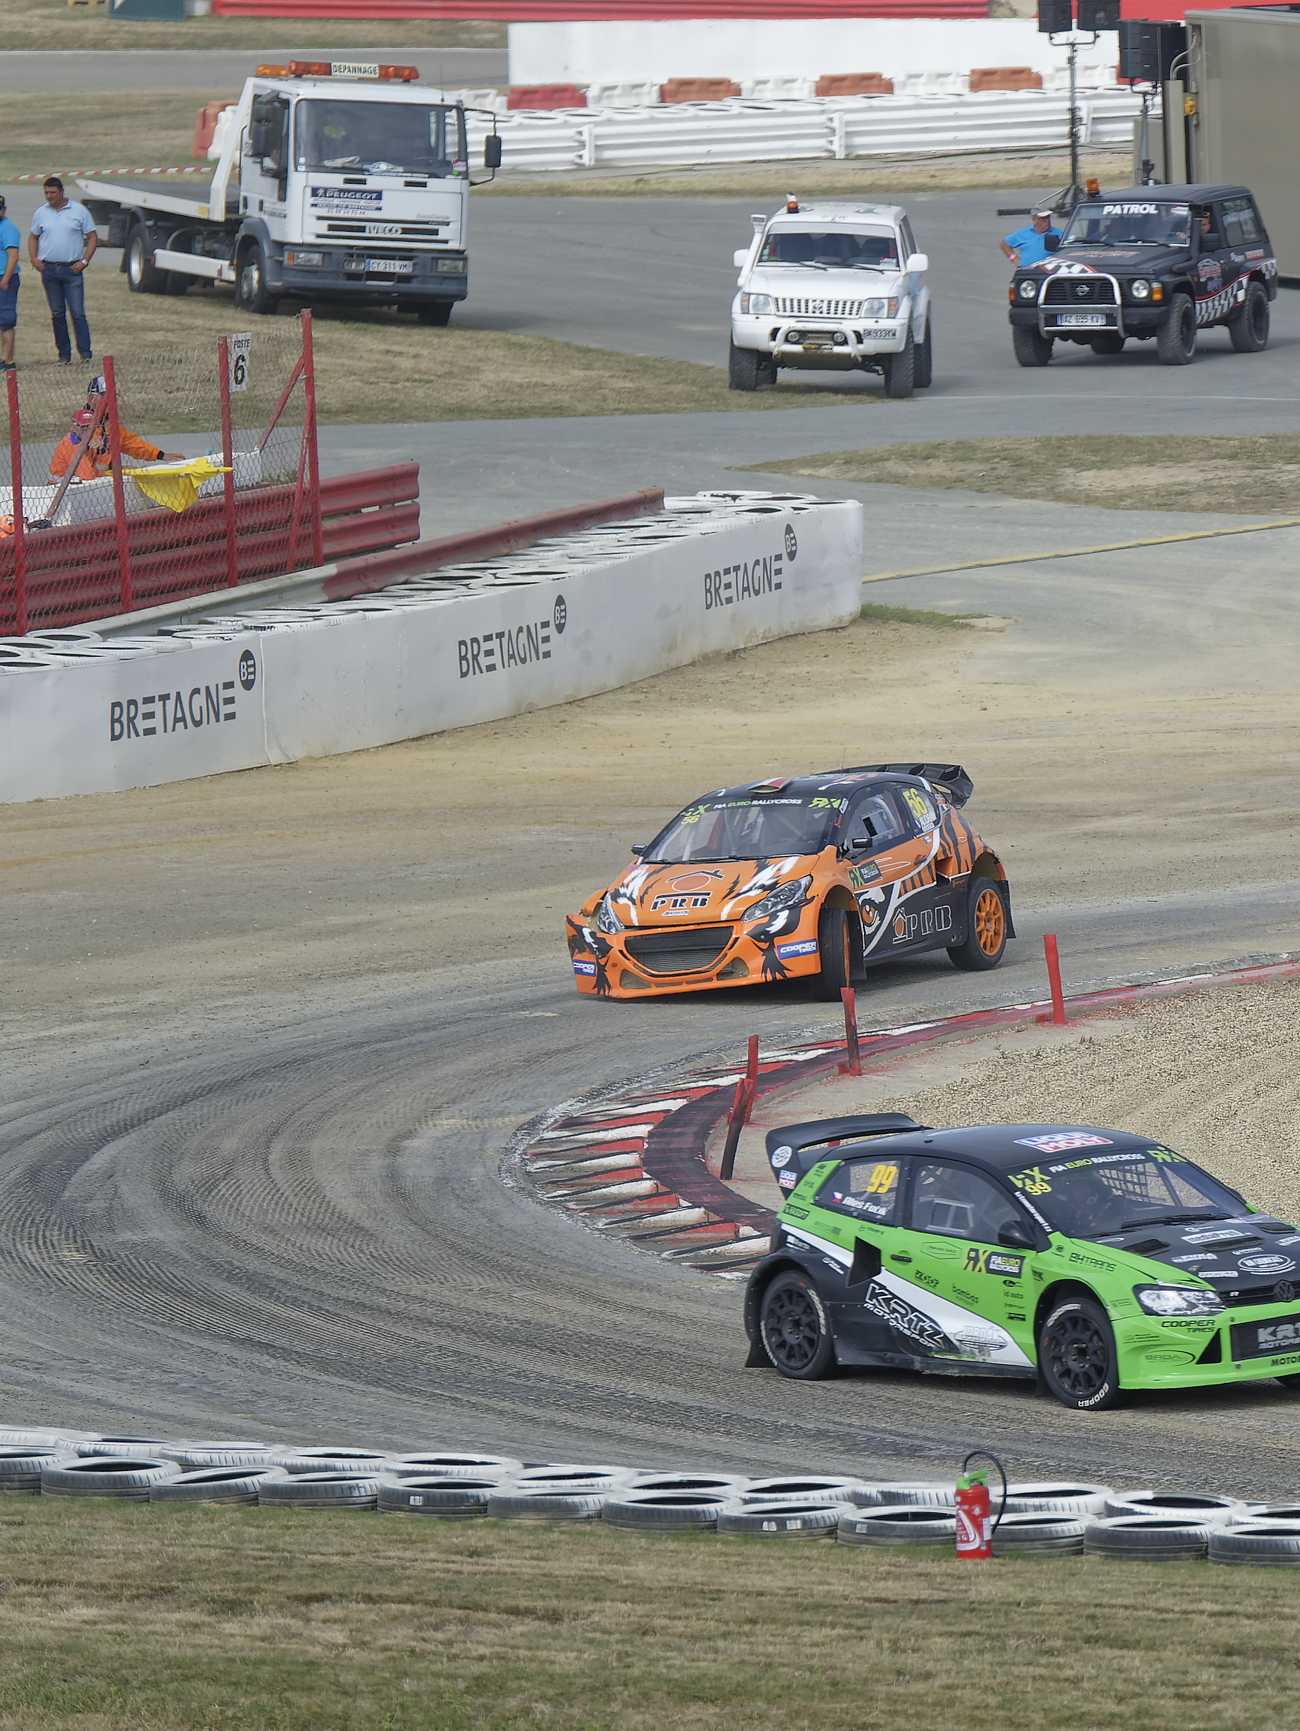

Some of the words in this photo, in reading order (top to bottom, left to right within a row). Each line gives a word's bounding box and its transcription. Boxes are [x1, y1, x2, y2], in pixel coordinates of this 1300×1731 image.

[325, 190, 378, 200] PEUGEOT
[1103, 204, 1159, 215] PATROL
[233, 354, 246, 385] 6
[704, 553, 783, 610] BRETAGNE
[458, 620, 552, 679] BRETAGNE
[110, 680, 237, 742] BRETAGNE
[751, 798, 803, 806] RALLYCROSS
[902, 787, 929, 818] 56
[650, 897, 709, 911] PRB
[905, 905, 952, 940] PRB
[779, 942, 817, 954] COOPER
[1036, 1136, 1105, 1151] MOLY
[1049, 1163, 1068, 1173] FIA
[1066, 1158, 1092, 1169] EURO
[1092, 1153, 1146, 1164] RALLYCROSS
[866, 1164, 898, 1193] 99
[1024, 1181, 1052, 1196] 99
[863, 1302, 937, 1349] MOTORSPOR
[1161, 1319, 1216, 1328] COOPER
[1077, 1382, 1109, 1407] COOPER
